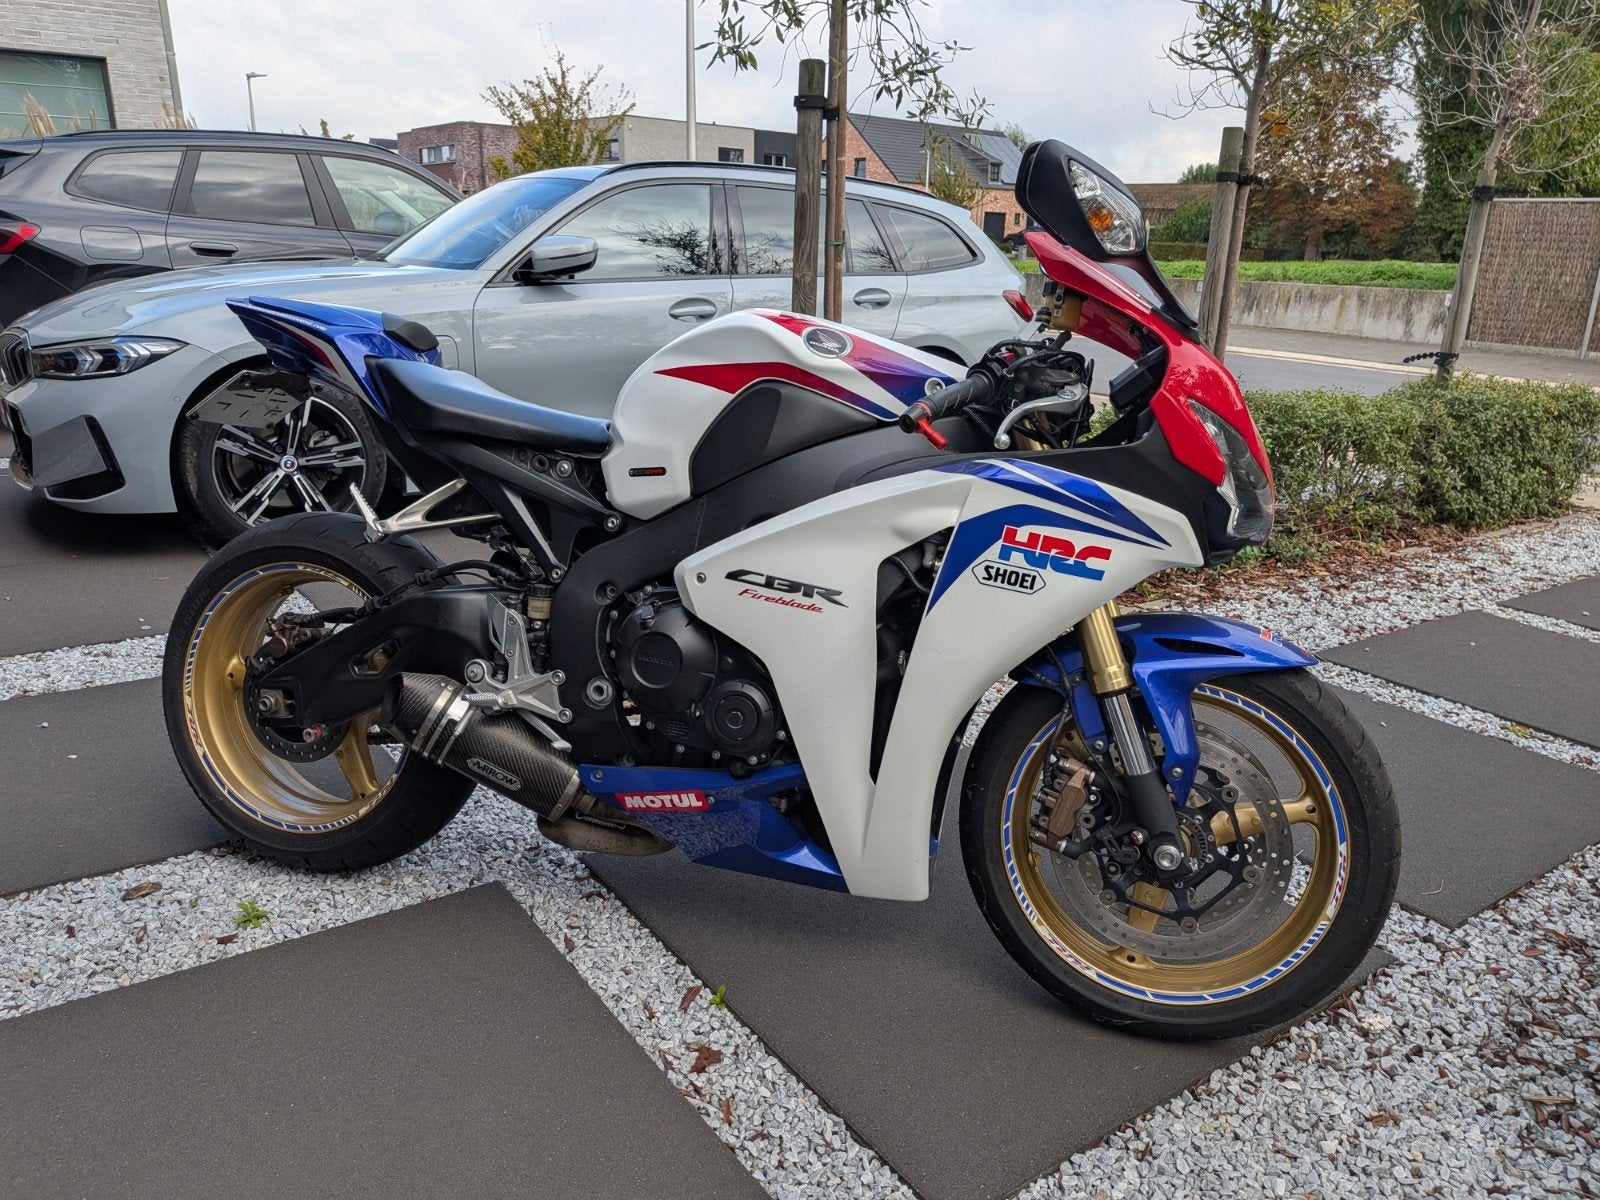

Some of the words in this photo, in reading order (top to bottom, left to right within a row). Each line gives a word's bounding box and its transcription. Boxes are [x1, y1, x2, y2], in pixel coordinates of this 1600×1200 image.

[997, 524, 1113, 582] HRC
[724, 568, 850, 609] CBR
[982, 564, 1037, 591] SHOEI
[737, 588, 823, 613] Fireblade
[471, 759, 519, 786] ARROW
[624, 793, 703, 808] MOTUL
